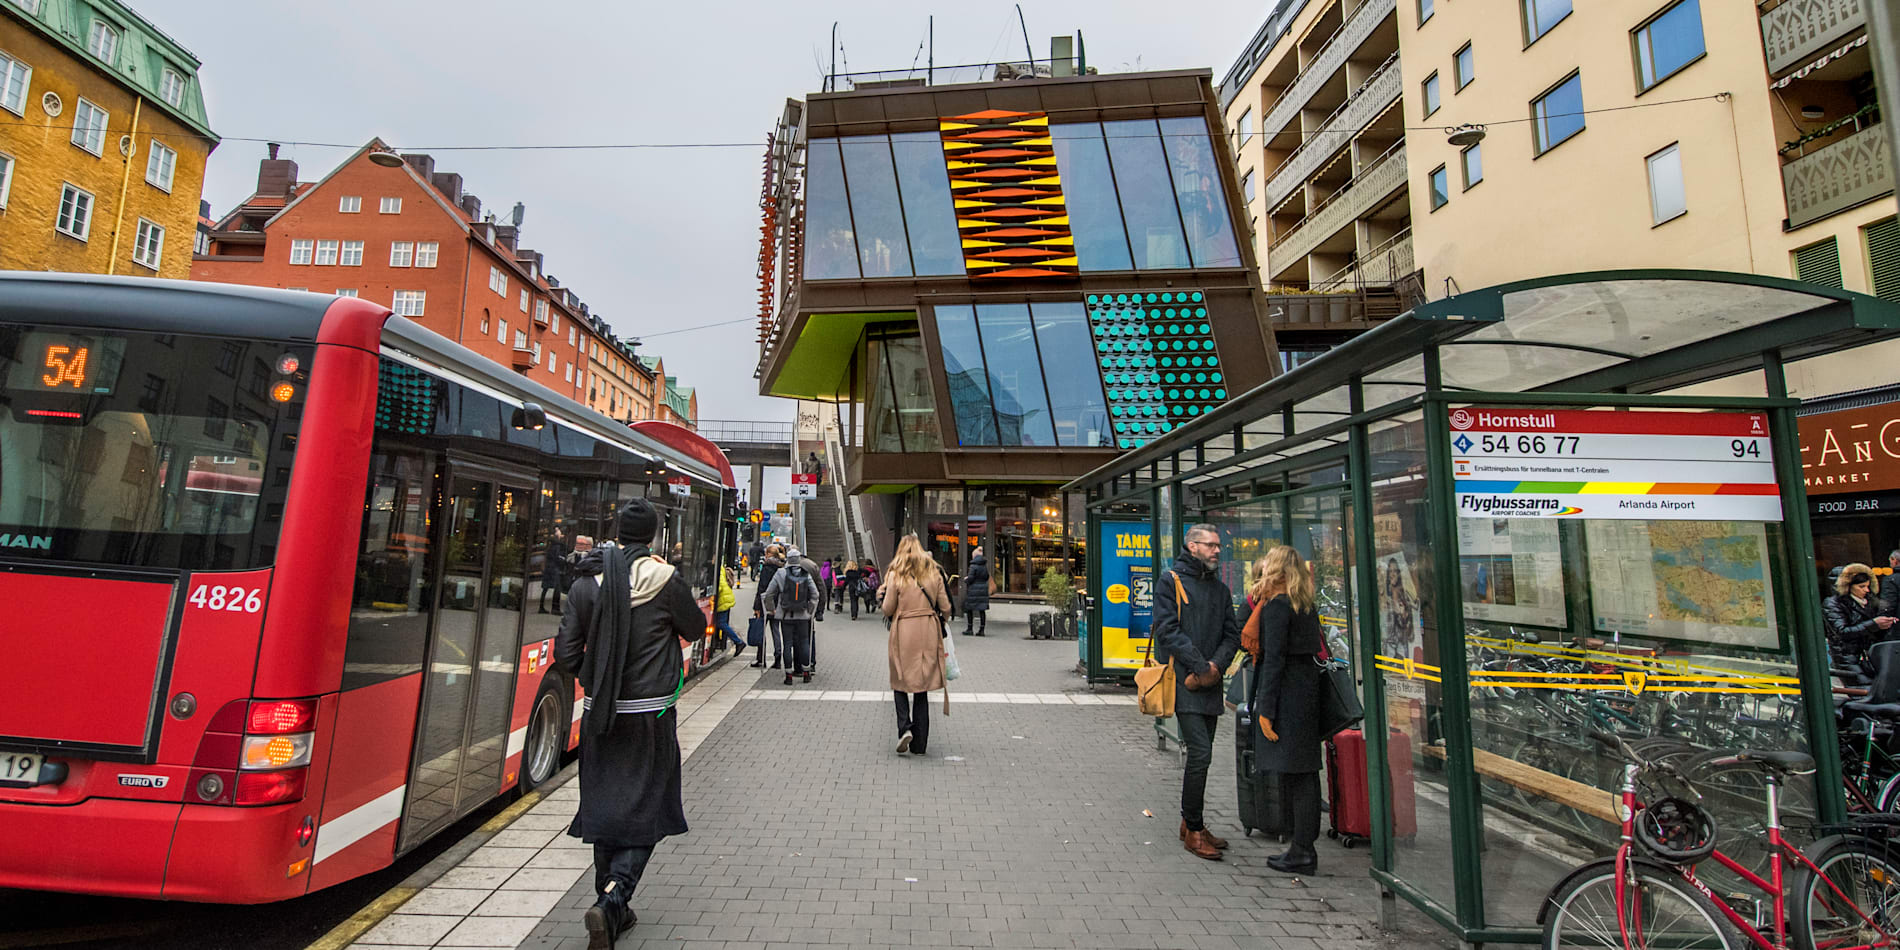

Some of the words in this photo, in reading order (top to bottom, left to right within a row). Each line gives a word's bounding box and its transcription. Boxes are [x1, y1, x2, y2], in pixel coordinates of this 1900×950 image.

[43, 346, 88, 388] 54
[1478, 413, 1555, 428] Hornstull
[1752, 420, 1761, 430] A
[1458, 438, 1467, 449] 4
[1482, 435, 1510, 453] 54
[1517, 435, 1546, 454] 66
[1553, 436, 1580, 454] 77
[1730, 439, 1761, 458] 94
[1474, 465, 1519, 473] Ersättningsbuss
[1530, 465, 1562, 473] tunnelbana
[1804, 473, 1870, 486] MARKET
[1461, 495, 1559, 512] Flygbussarna
[1619, 500, 1658, 509] Arlanda
[1660, 501, 1695, 511] Airport
[1818, 502, 1847, 512] FOOD
[1855, 500, 1879, 510] BAR
[190, 584, 262, 613] 4826
[5, 755, 32, 776] 19
[121, 777, 150, 786] EURO
[155, 778, 164, 787] 6
